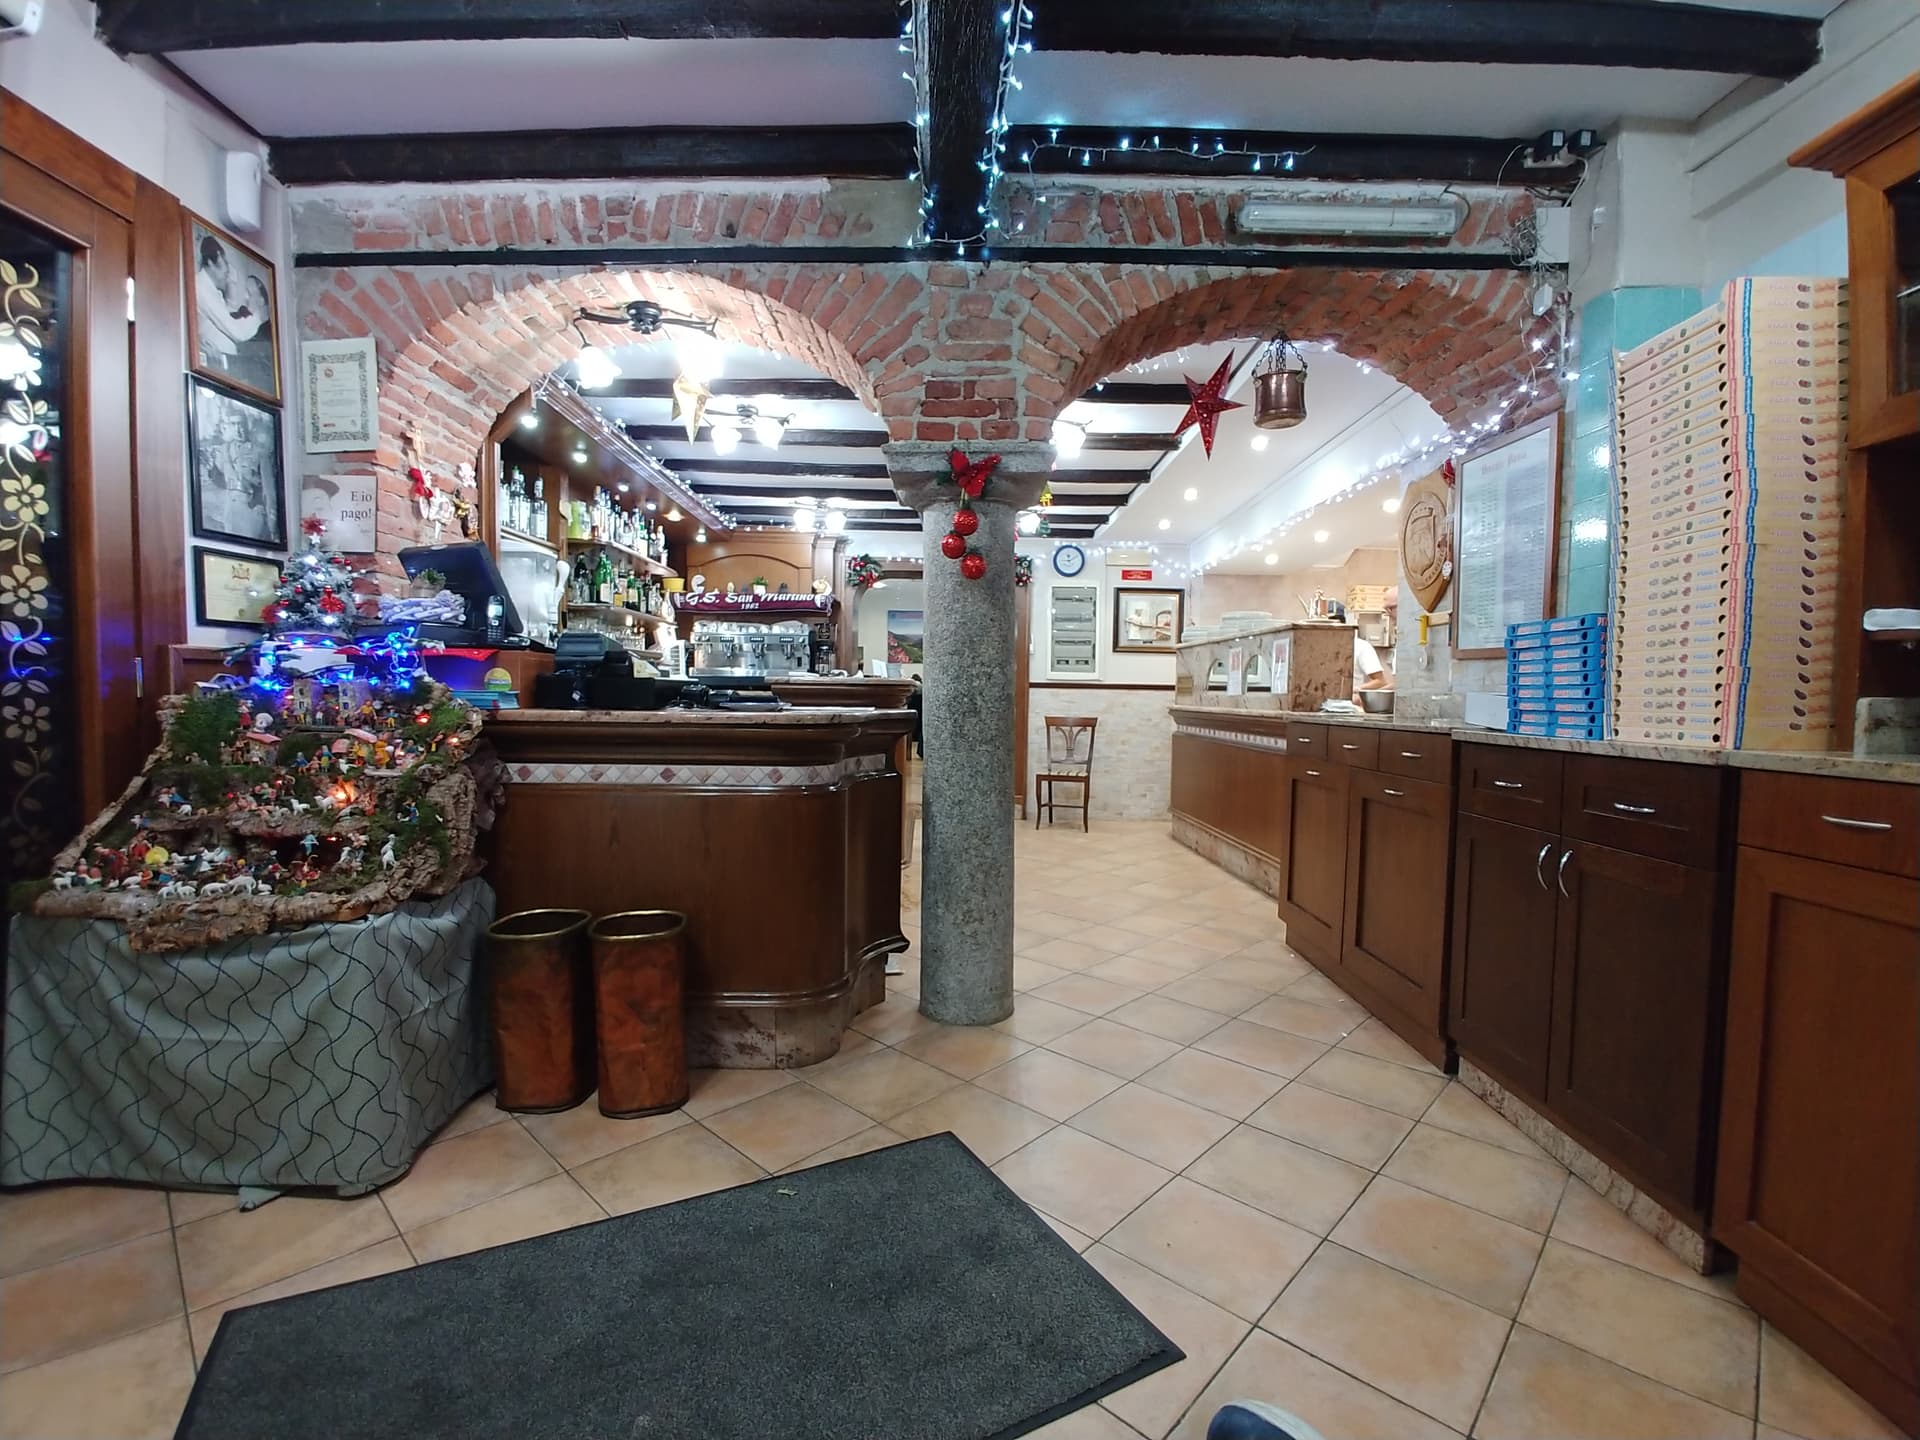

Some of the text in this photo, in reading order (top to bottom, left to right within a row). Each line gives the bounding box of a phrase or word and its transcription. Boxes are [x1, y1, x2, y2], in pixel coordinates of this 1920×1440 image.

[351, 491, 372, 502] E io
[341, 508, 372, 521] pago!
[685, 591, 719, 606] G.S.
[725, 592, 754, 603] San
